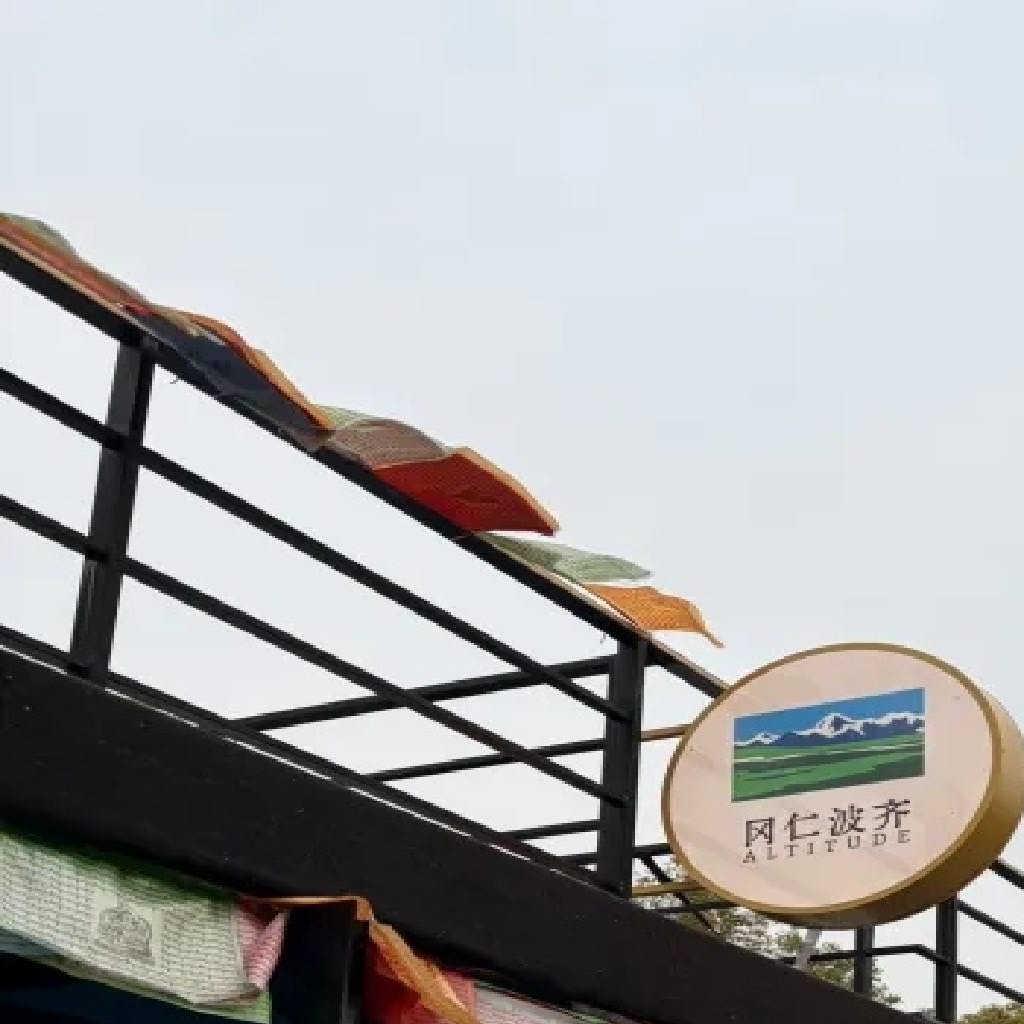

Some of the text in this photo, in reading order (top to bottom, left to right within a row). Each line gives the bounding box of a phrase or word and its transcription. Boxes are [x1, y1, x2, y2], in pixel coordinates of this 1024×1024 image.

[744, 798, 911, 847] 冈仁波齐
[743, 829, 911, 863] ALTITUDE
